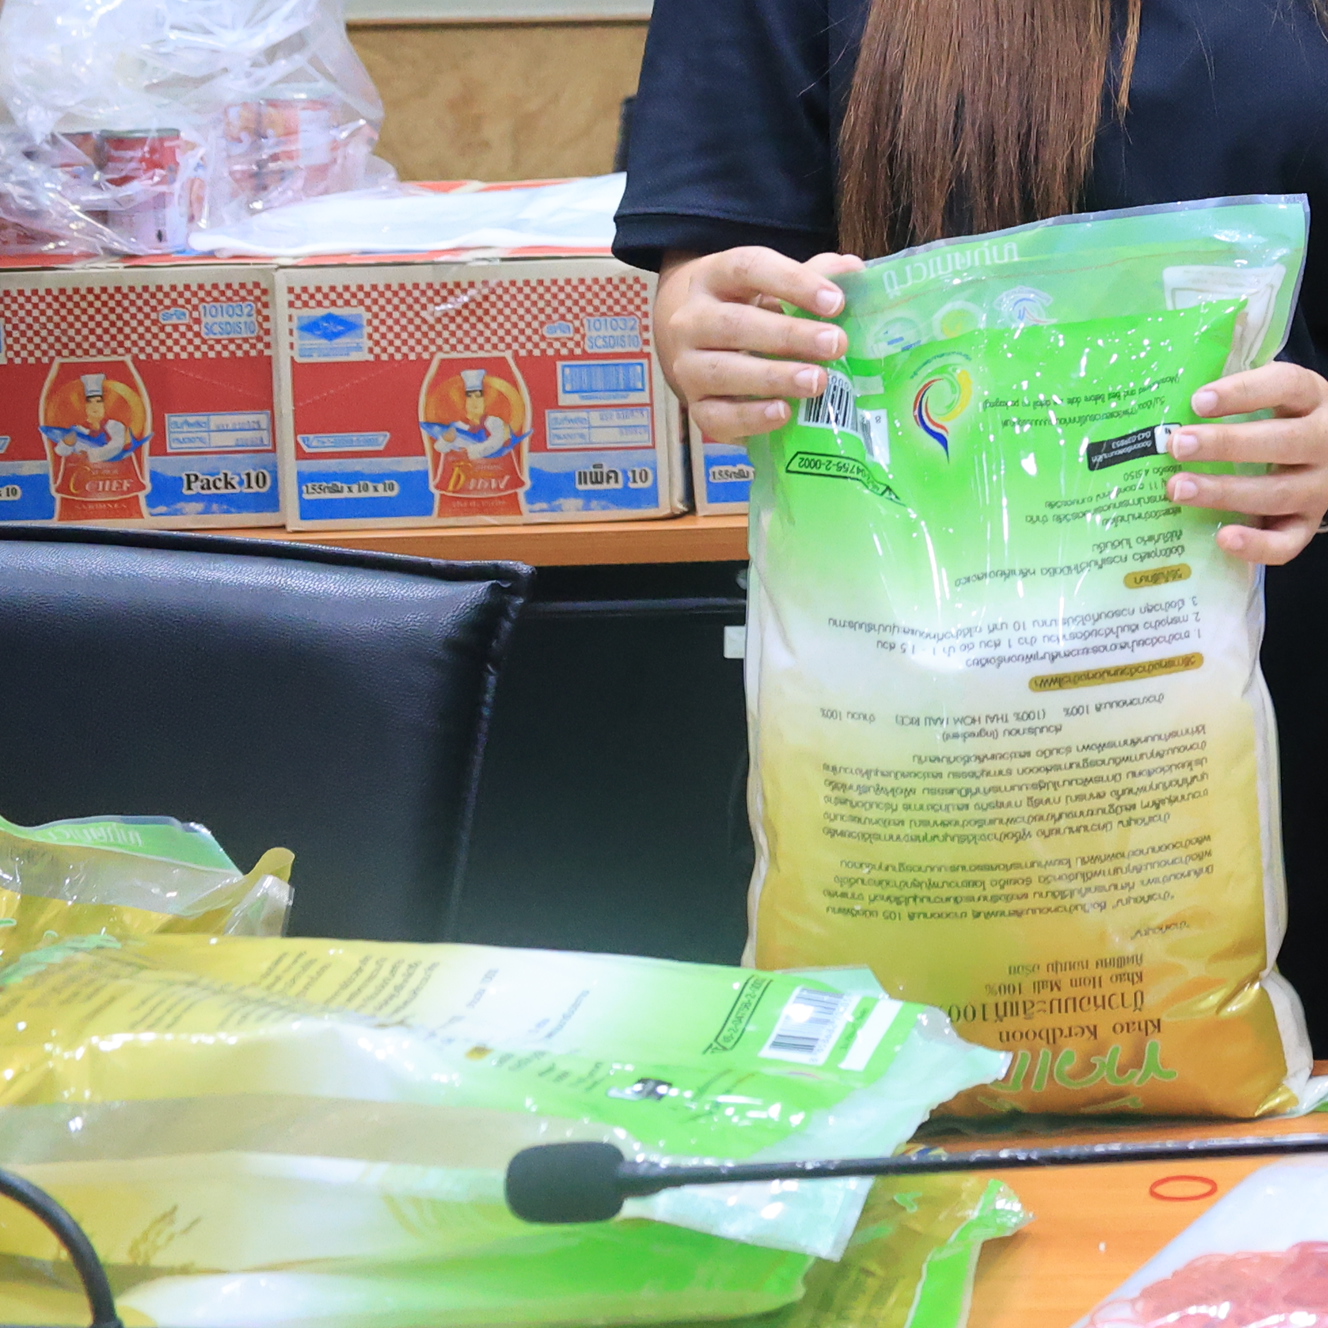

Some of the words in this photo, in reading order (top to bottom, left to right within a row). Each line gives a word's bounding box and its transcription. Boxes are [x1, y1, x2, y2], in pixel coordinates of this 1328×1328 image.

[201, 303, 255, 319] 101032
[204, 321, 256, 337] SCSDIS10
[586, 317, 638, 333] 101032
[587, 336, 640, 350] SCSDIS10
[185, 471, 237, 492] Pack
[243, 471, 267, 491] 10
[577, 464, 620, 487] แพ็ค
[629, 468, 649, 484] 10
[356, 482, 370, 494] 10
[381, 481, 395, 493] 10
[1189, 595, 1198, 607] 3.
[1193, 611, 1200, 621] 2.
[1013, 620, 1027, 631] 10
[1193, 628, 1201, 639] 1.
[1007, 638, 1012, 648] 1
[820, 707, 843, 720] 100%
[984, 711, 1010, 723] THAI
[1013, 707, 1046, 724] (100%
[1063, 704, 1090, 717] 100%
[894, 714, 922, 725] RICE)
[953, 714, 982, 725] HOM
[940, 728, 999, 742] (Ingredient)
[883, 910, 902, 921] 105
[1032, 978, 1062, 993] Mali
[1070, 975, 1103, 990] Hom
[1109, 971, 1144, 991] Khao
[984, 981, 1024, 996] 100%
[998, 1023, 1099, 1045] Kerdboon
[1112, 1018, 1162, 1037] Khao
